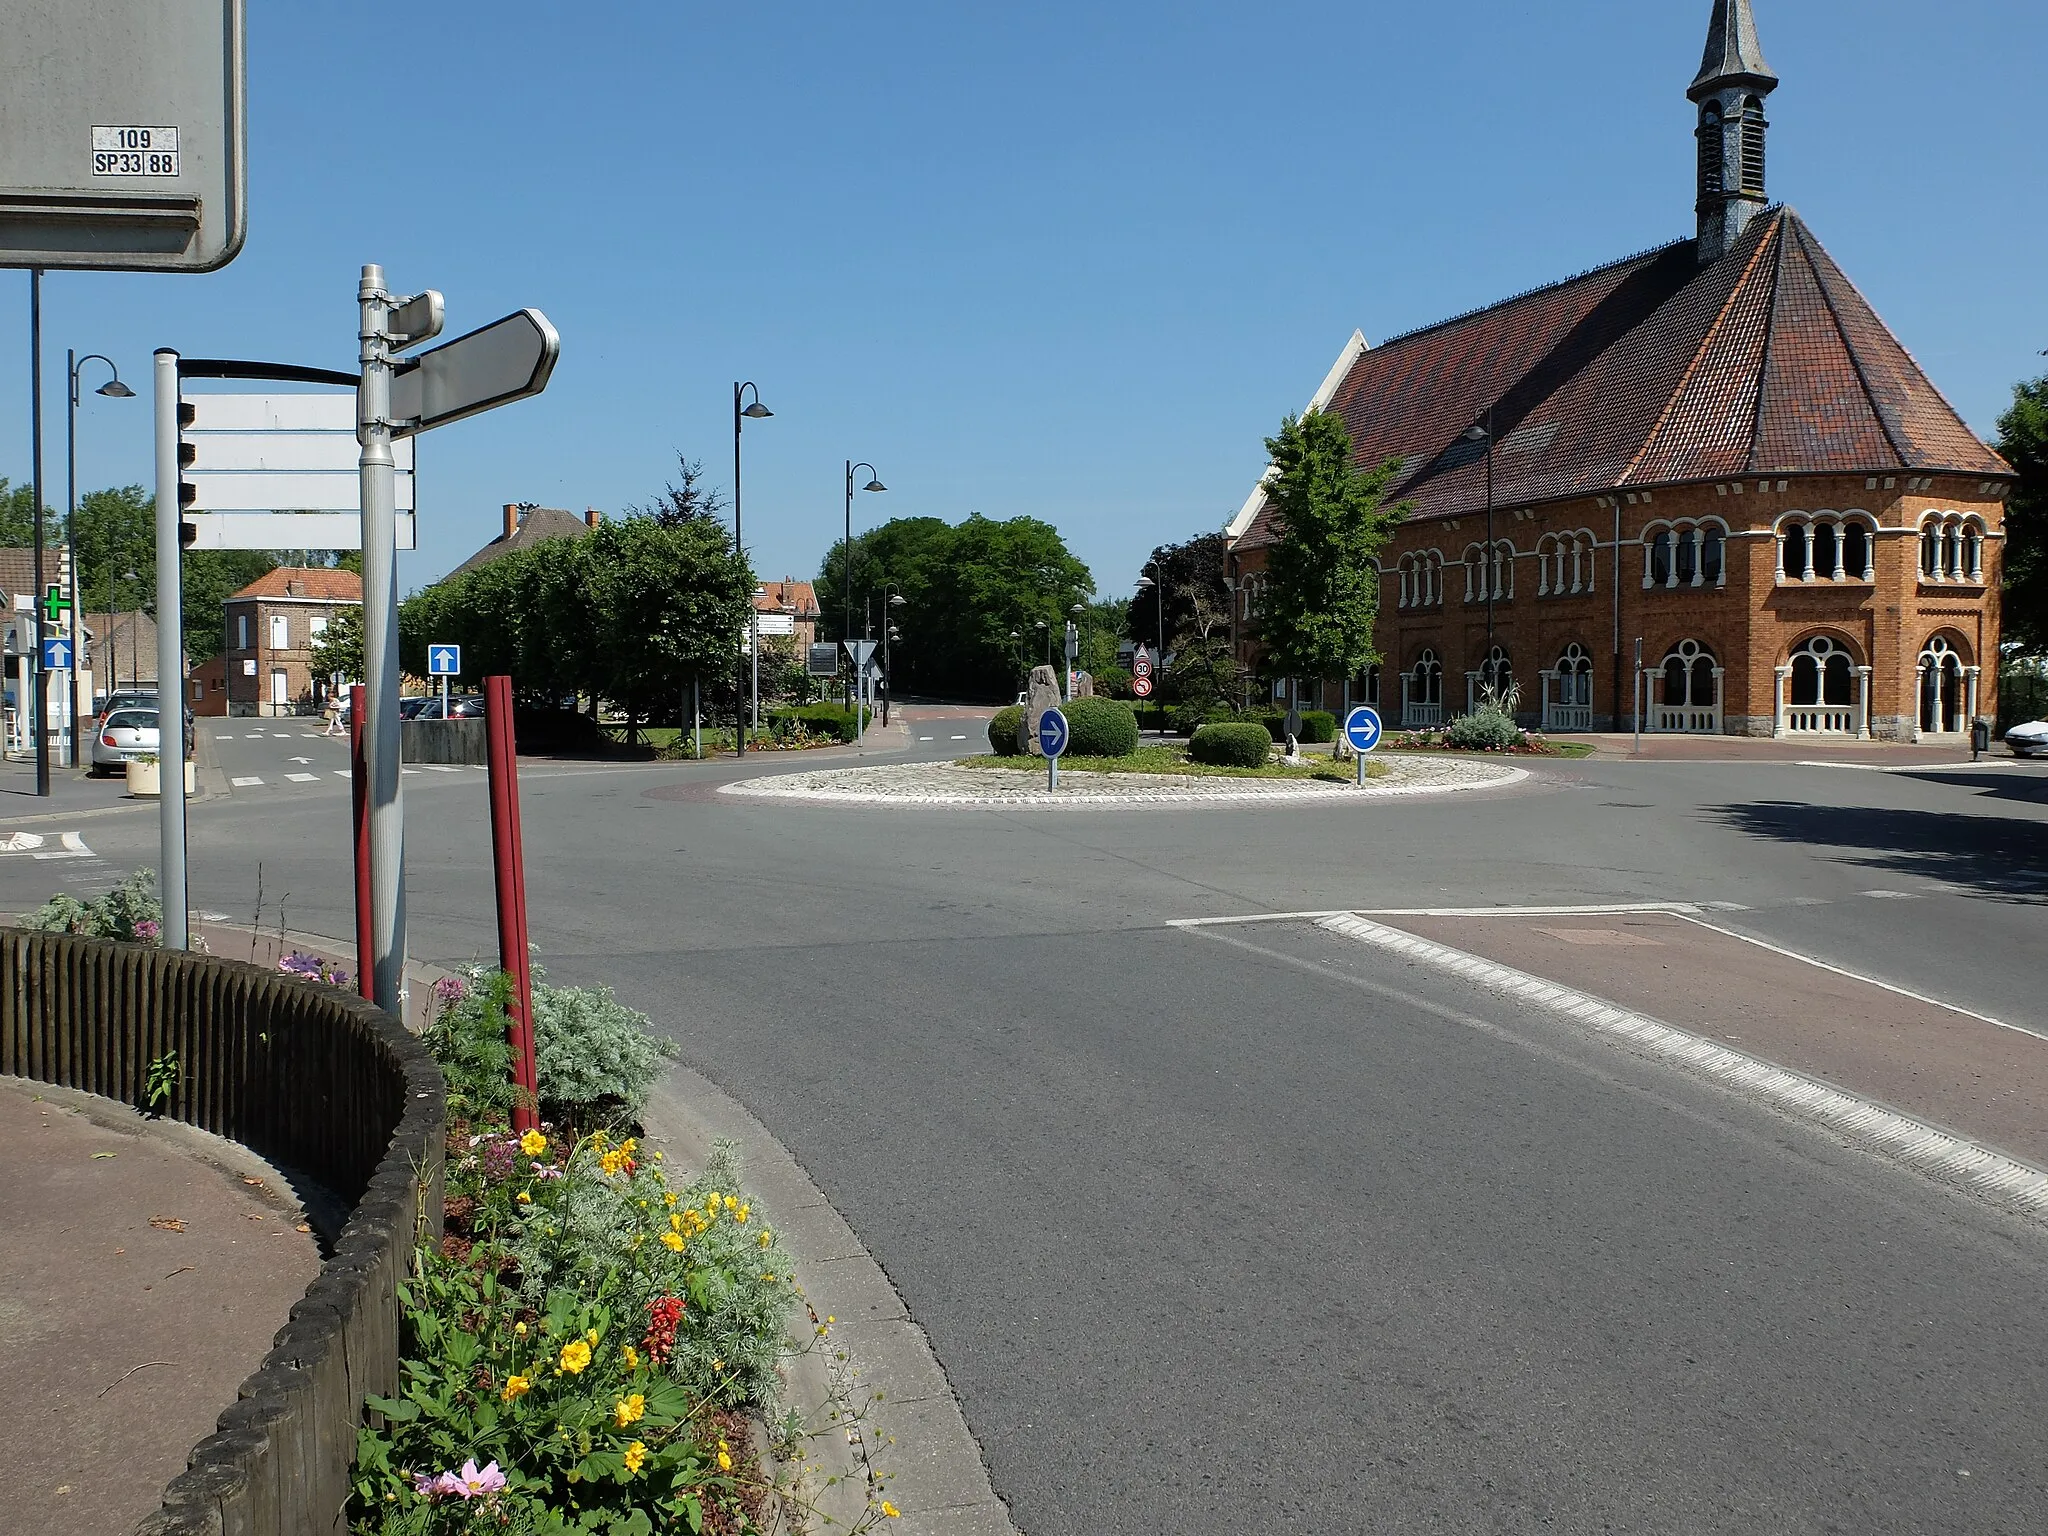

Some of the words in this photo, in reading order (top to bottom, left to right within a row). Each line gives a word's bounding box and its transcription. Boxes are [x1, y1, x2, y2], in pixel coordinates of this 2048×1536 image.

[118, 129, 151, 149] 109
[95, 154, 141, 173] SP33
[150, 154, 173, 173] 88
[1137, 665, 1148, 673] 30
